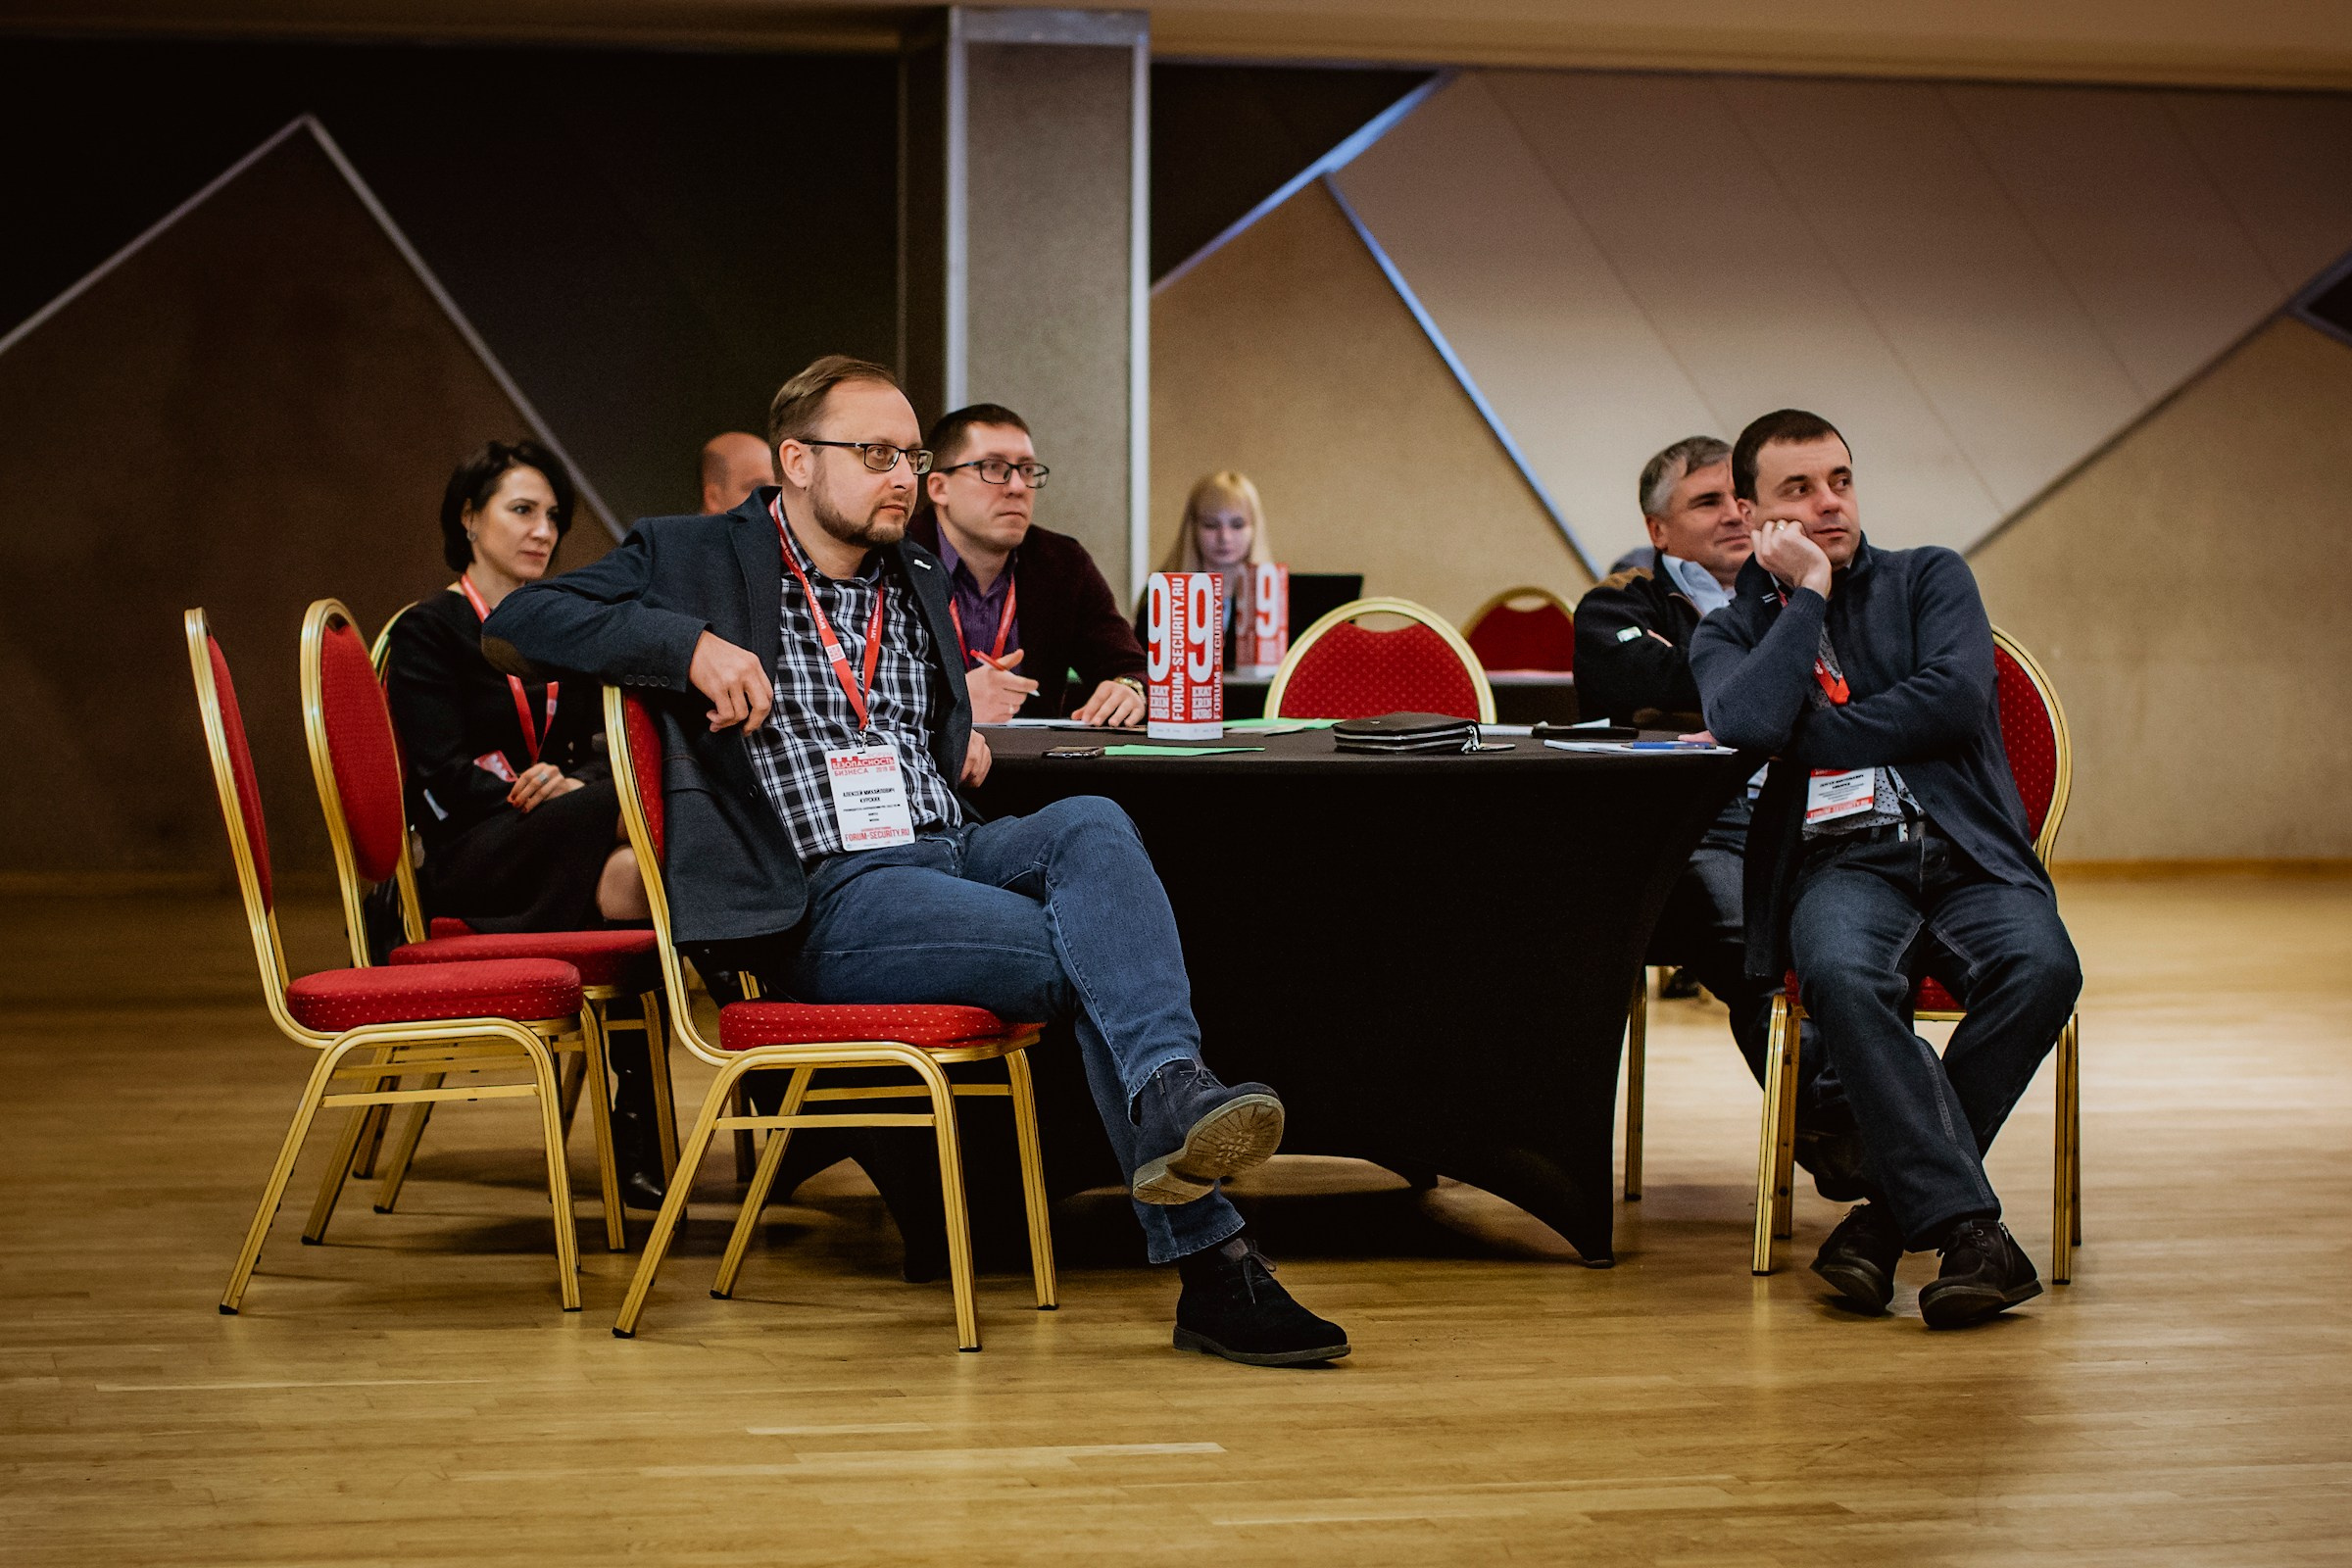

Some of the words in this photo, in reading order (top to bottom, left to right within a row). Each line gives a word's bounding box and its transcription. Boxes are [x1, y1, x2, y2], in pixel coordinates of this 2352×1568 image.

[1148, 572, 1171, 682] 9
[1188, 572, 1214, 683] 9
[1255, 561, 1278, 638] 9
[1172, 577, 1185, 720] FORUM-SECURITY.RU
[832, 758, 895, 769] БЕЗОПАСНОСТЬ
[834, 767, 869, 777] БИЗНЕСА
[845, 828, 910, 842] FORUM-SECURITY.RU
